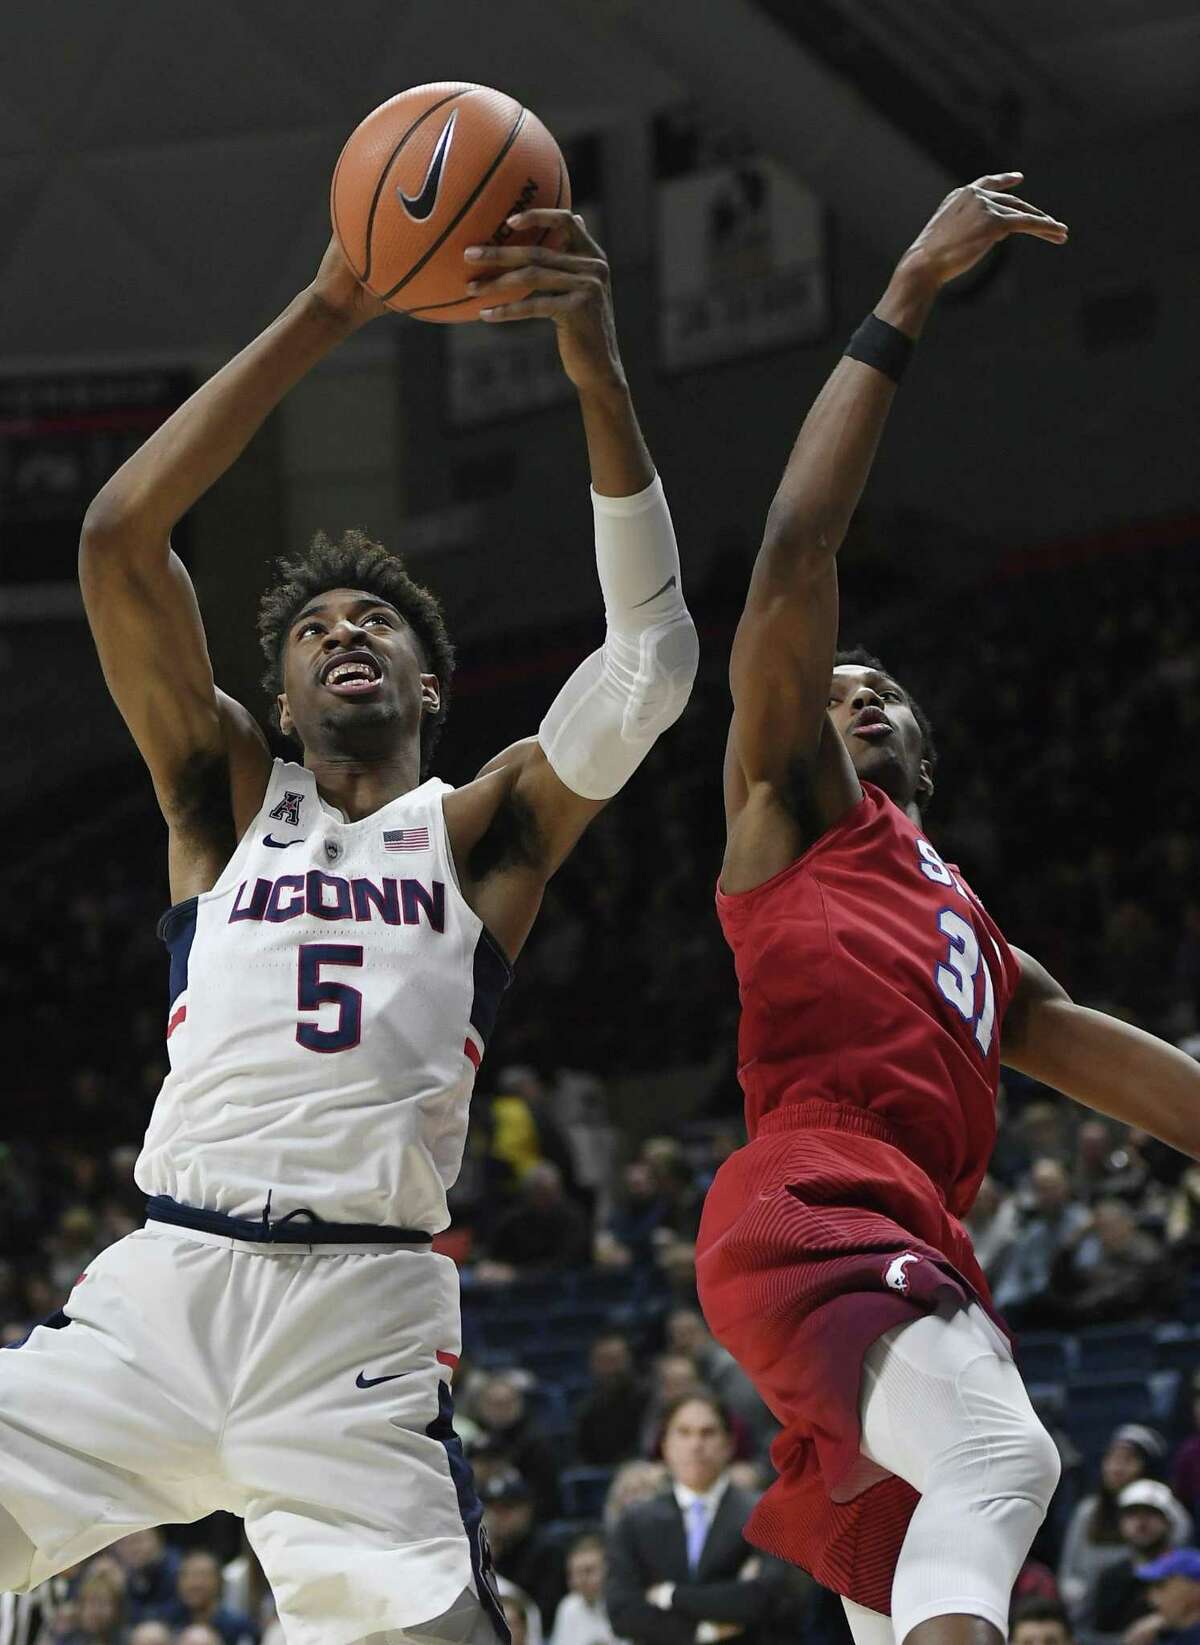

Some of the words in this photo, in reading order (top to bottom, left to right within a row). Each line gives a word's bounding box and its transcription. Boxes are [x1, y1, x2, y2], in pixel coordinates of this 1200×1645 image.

[228, 869, 445, 934] UCONN
[296, 943, 363, 1054] 5
[935, 905, 997, 1058] 31
